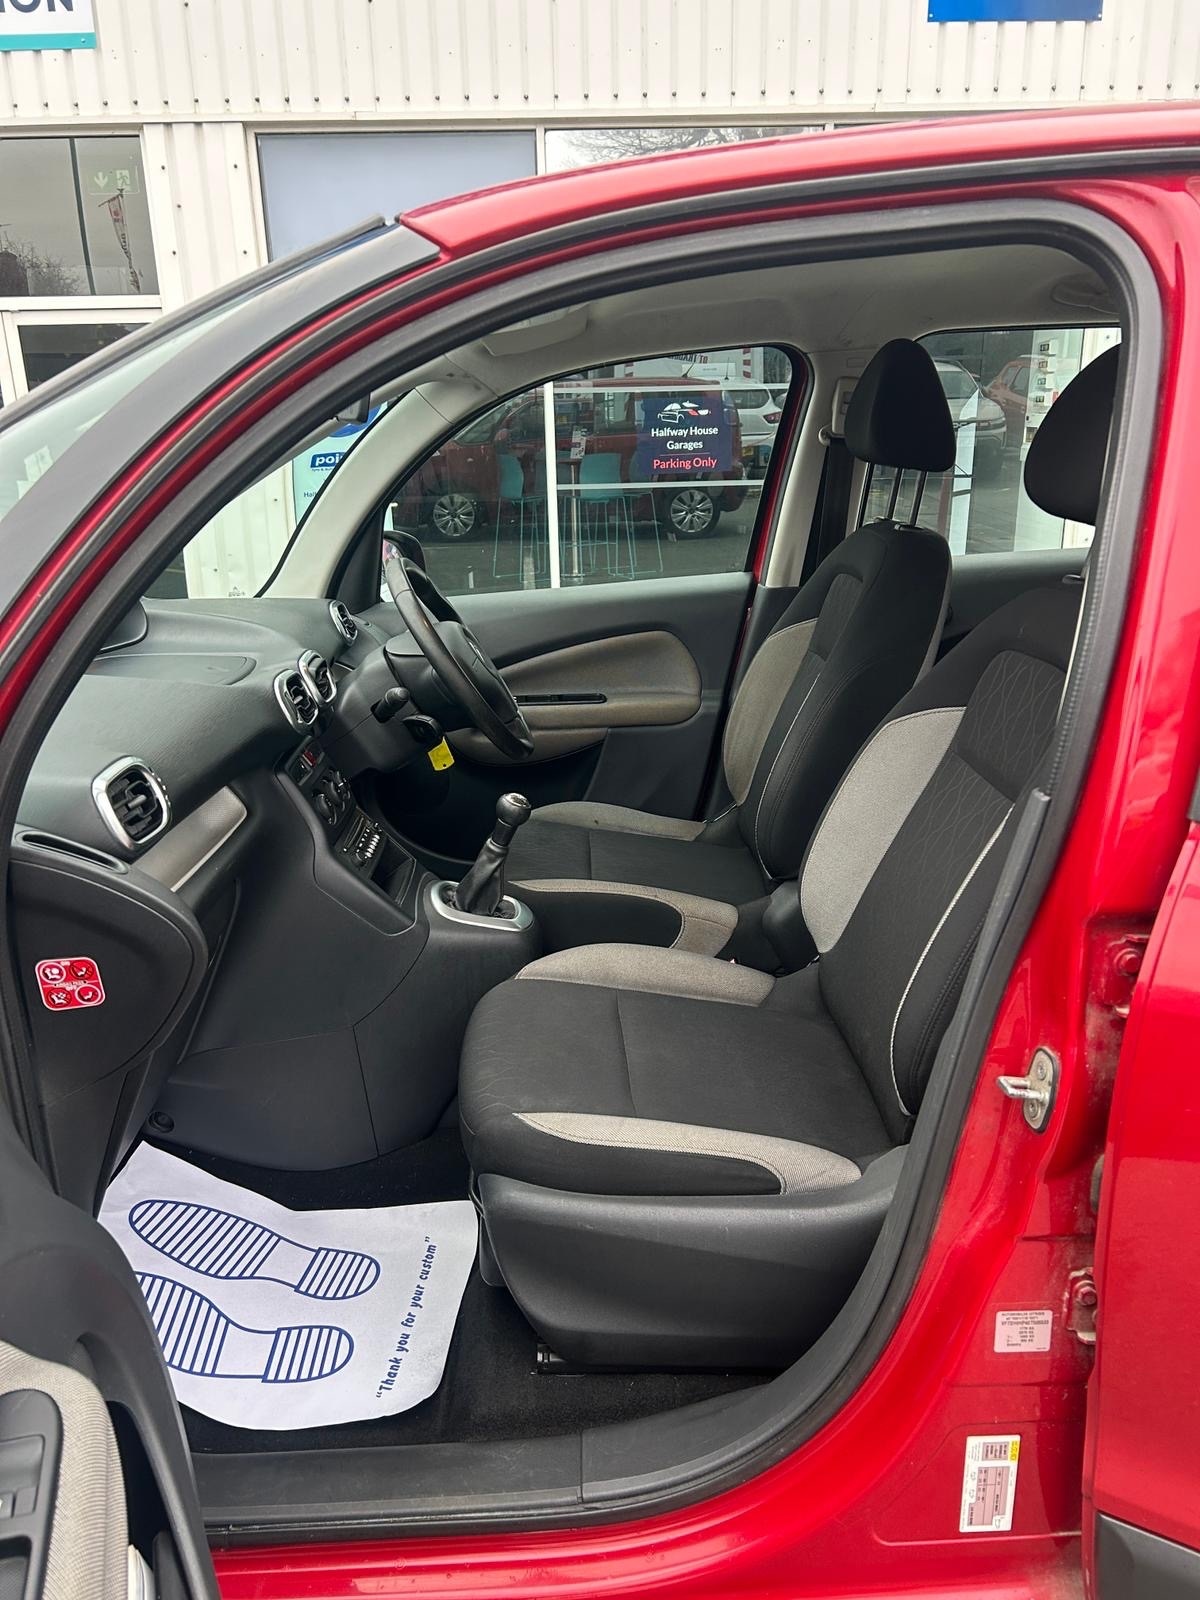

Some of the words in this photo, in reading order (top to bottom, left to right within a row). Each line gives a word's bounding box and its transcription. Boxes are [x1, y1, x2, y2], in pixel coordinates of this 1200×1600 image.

[651, 427, 688, 437] Halfway
[690, 426, 719, 436] House
[666, 440, 703, 450] Garages
[315, 453, 343, 467] poi
[653, 458, 692, 470] Parking
[693, 457, 717, 468] Only
[410, 1284, 425, 1309] your
[401, 1312, 416, 1328] for
[396, 1333, 410, 1353] you
